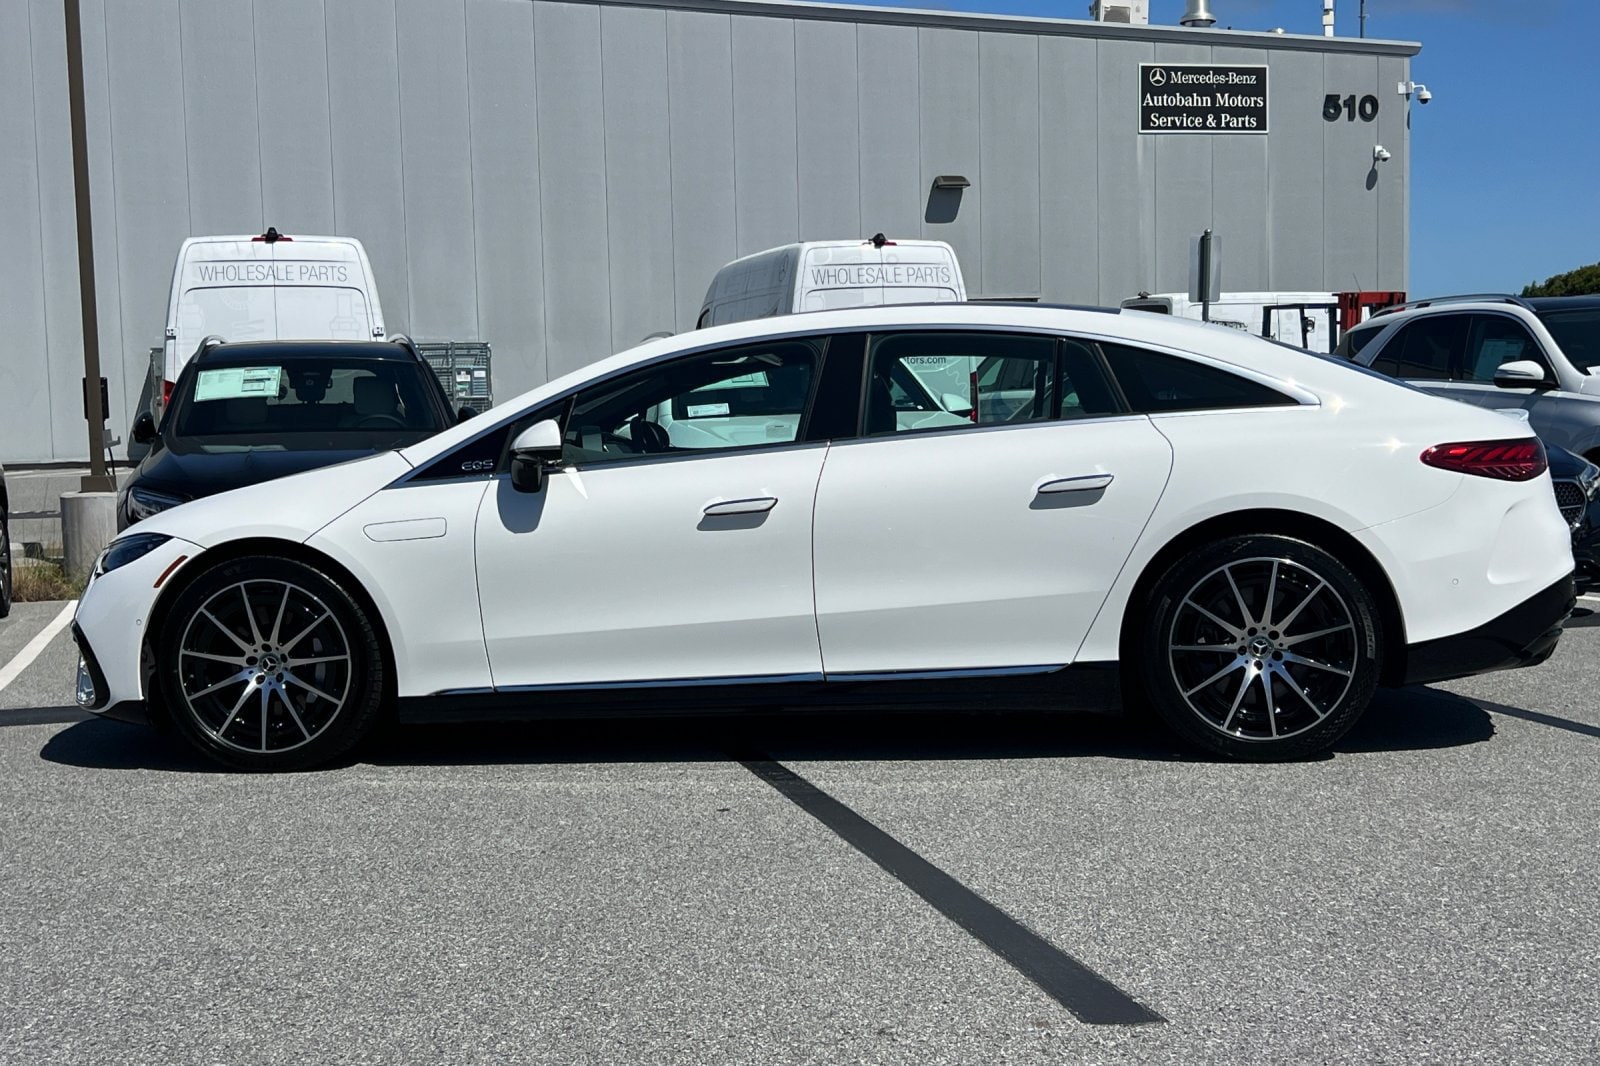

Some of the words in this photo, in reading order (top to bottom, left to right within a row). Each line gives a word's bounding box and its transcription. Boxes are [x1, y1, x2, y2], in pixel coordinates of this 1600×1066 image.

[1170, 70, 1257, 85] Mercedes-Benz
[1142, 92, 1211, 107] Autobahn
[1215, 93, 1264, 107] Motors
[1323, 94, 1379, 122] 510
[1150, 112, 1203, 127] Service
[1206, 113, 1217, 127] &
[1220, 113, 1257, 128] Parts
[199, 264, 294, 282] WHOLESALE
[299, 264, 348, 283] PARTS
[811, 267, 903, 285] WHOLESALE
[907, 266, 951, 284] PARTS
[904, 356, 947, 366] tors.com
[461, 459, 494, 471] EQS
